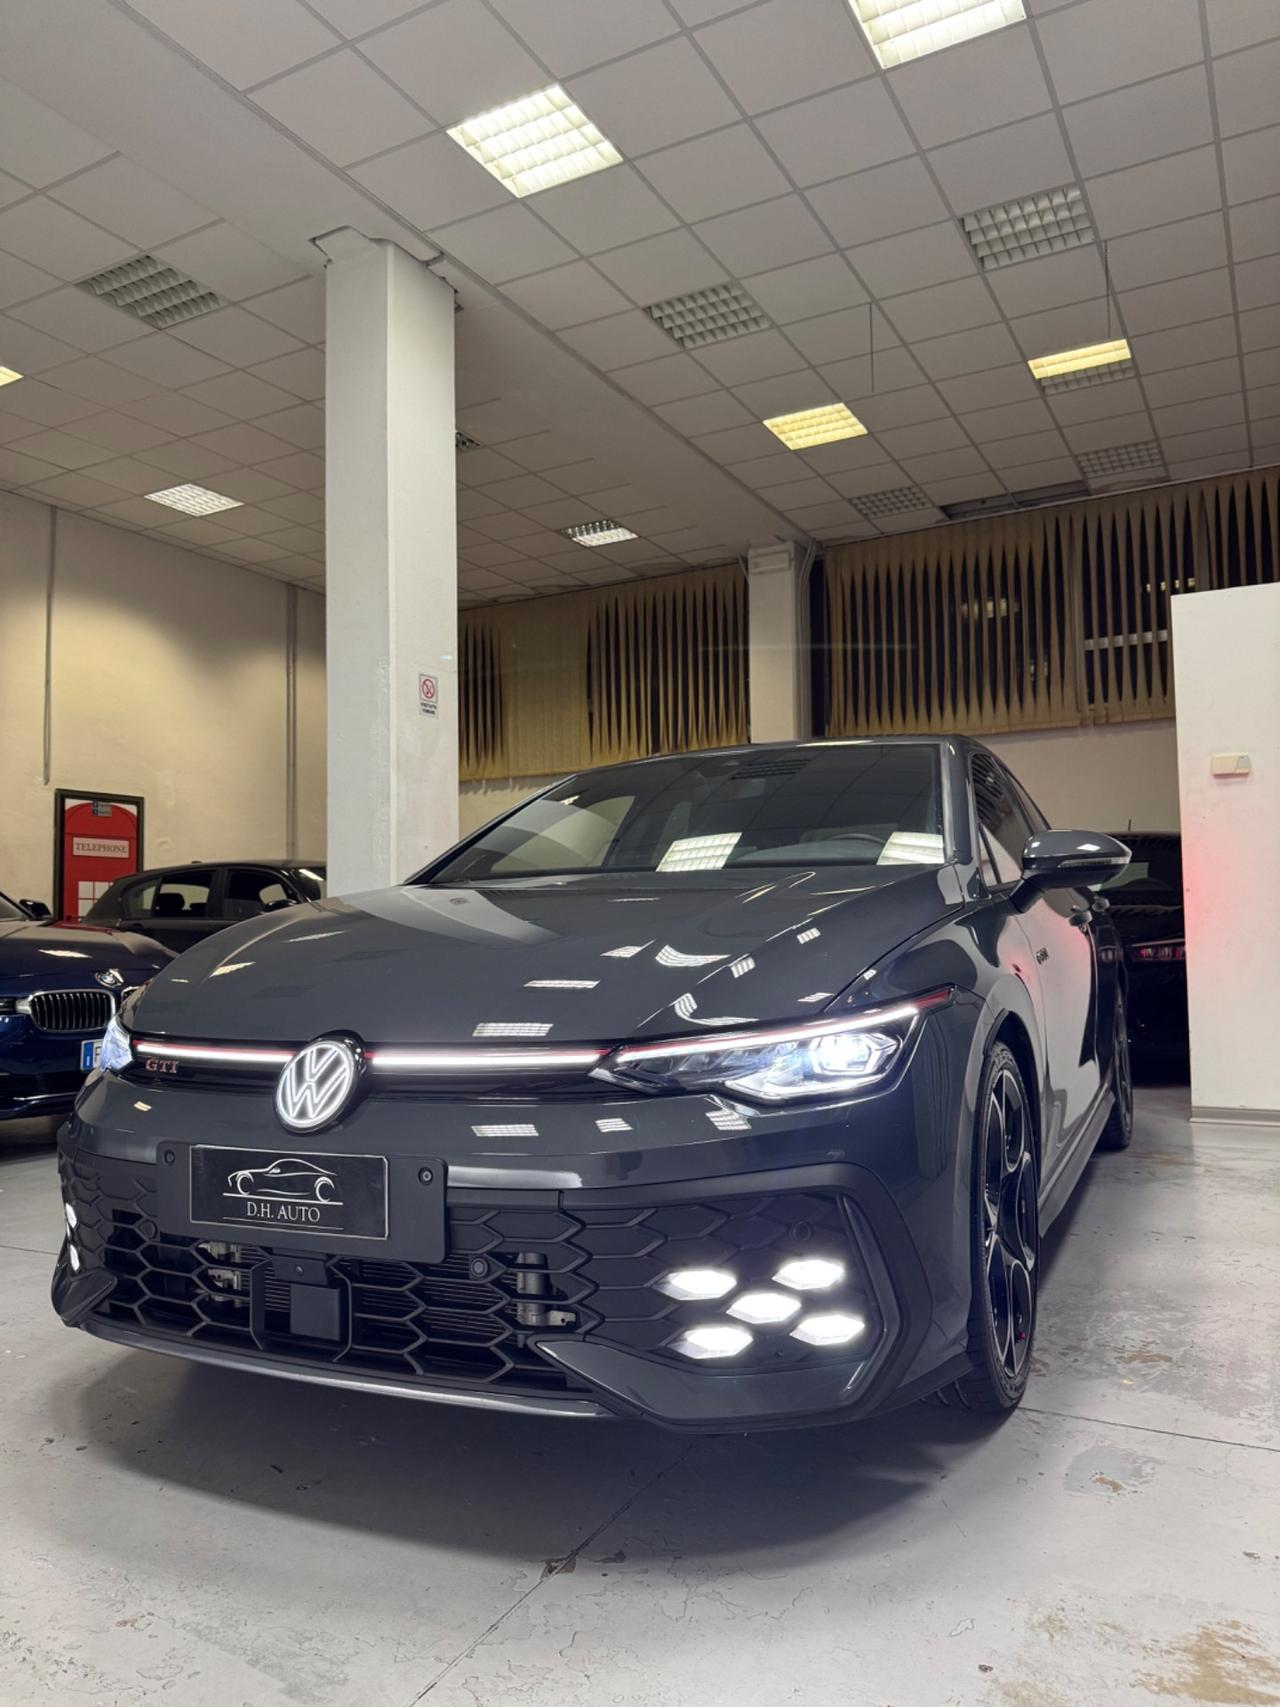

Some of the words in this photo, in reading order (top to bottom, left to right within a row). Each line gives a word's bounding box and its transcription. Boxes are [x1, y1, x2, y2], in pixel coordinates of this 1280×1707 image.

[75, 842, 128, 854] TELEPHONE
[145, 1057, 179, 1074] GTI
[247, 1201, 274, 1218] D.H.
[277, 1204, 320, 1222] AUTO
